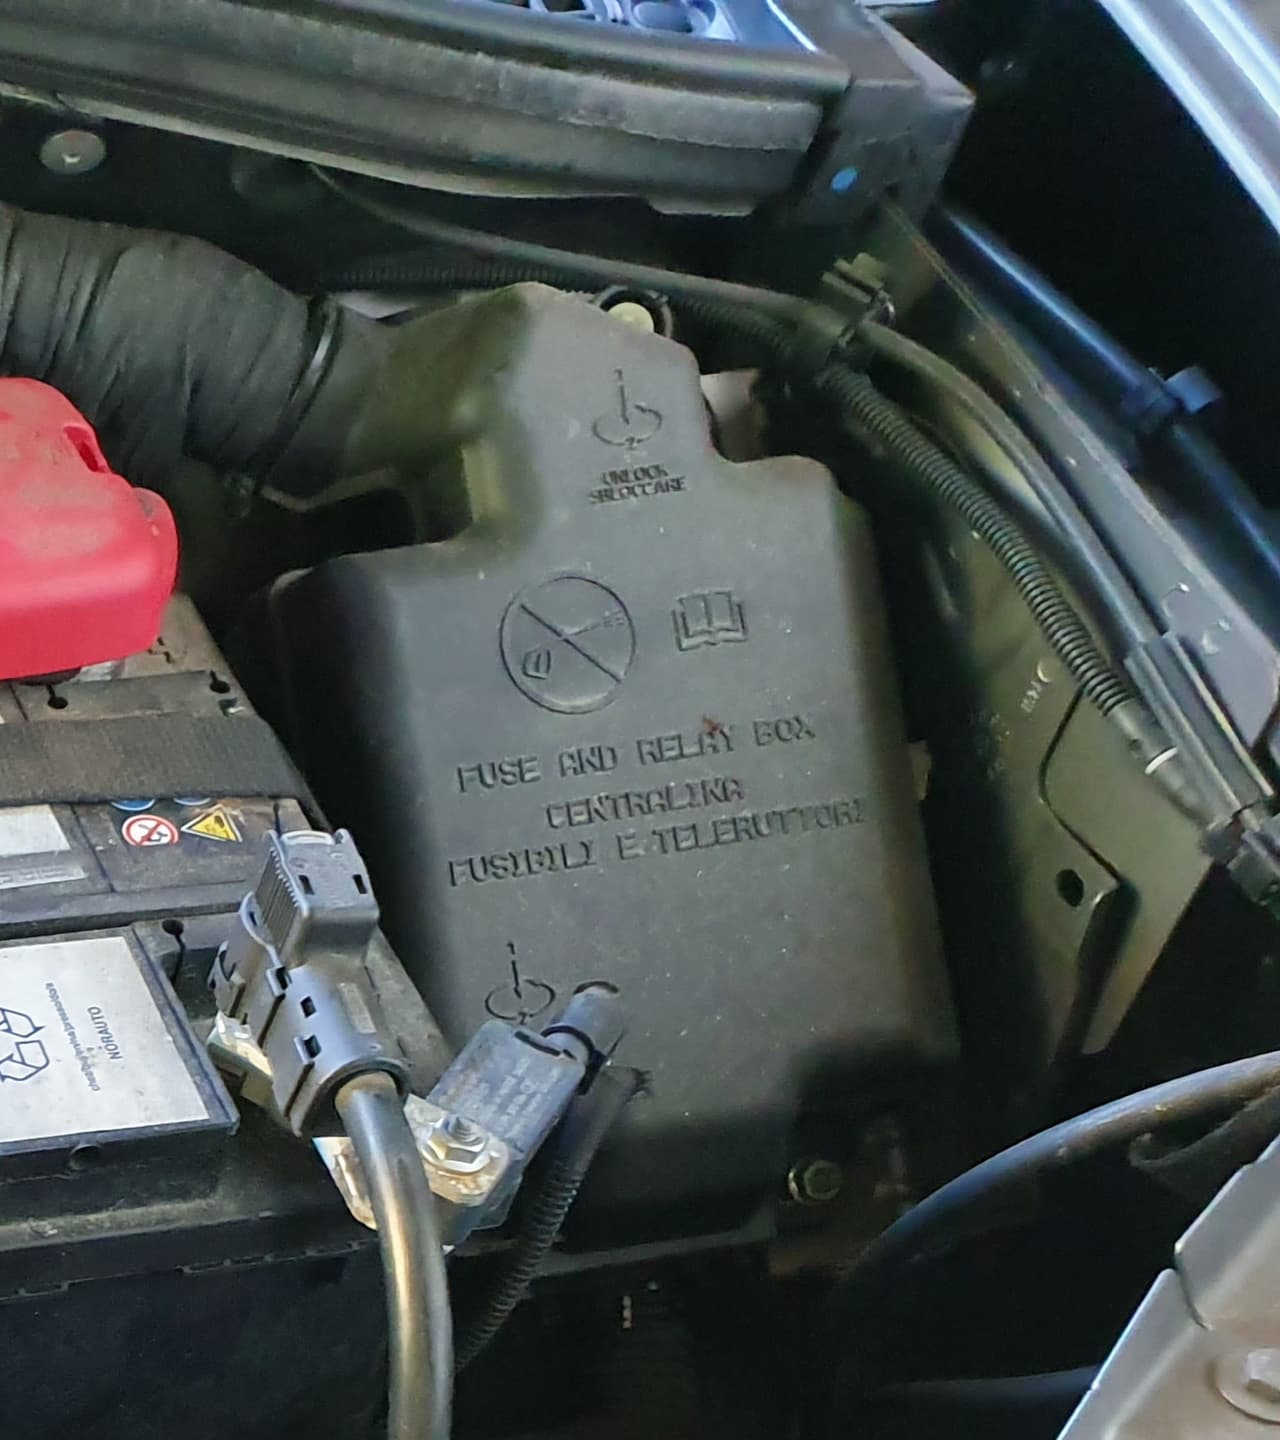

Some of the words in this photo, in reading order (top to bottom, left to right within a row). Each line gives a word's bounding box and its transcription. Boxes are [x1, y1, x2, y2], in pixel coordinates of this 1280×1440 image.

[457, 757, 540, 793] FUSE
[558, 745, 618, 777] AND
[639, 724, 736, 766] RELAY
[753, 715, 816, 748] BOX
[546, 778, 744, 830] CENTRALINA
[448, 840, 593, 888] FUSIBILI
[617, 831, 645, 861] E
[651, 799, 866, 855] TELERUTTORI
[87, 1006, 124, 1060] NORAUTO
